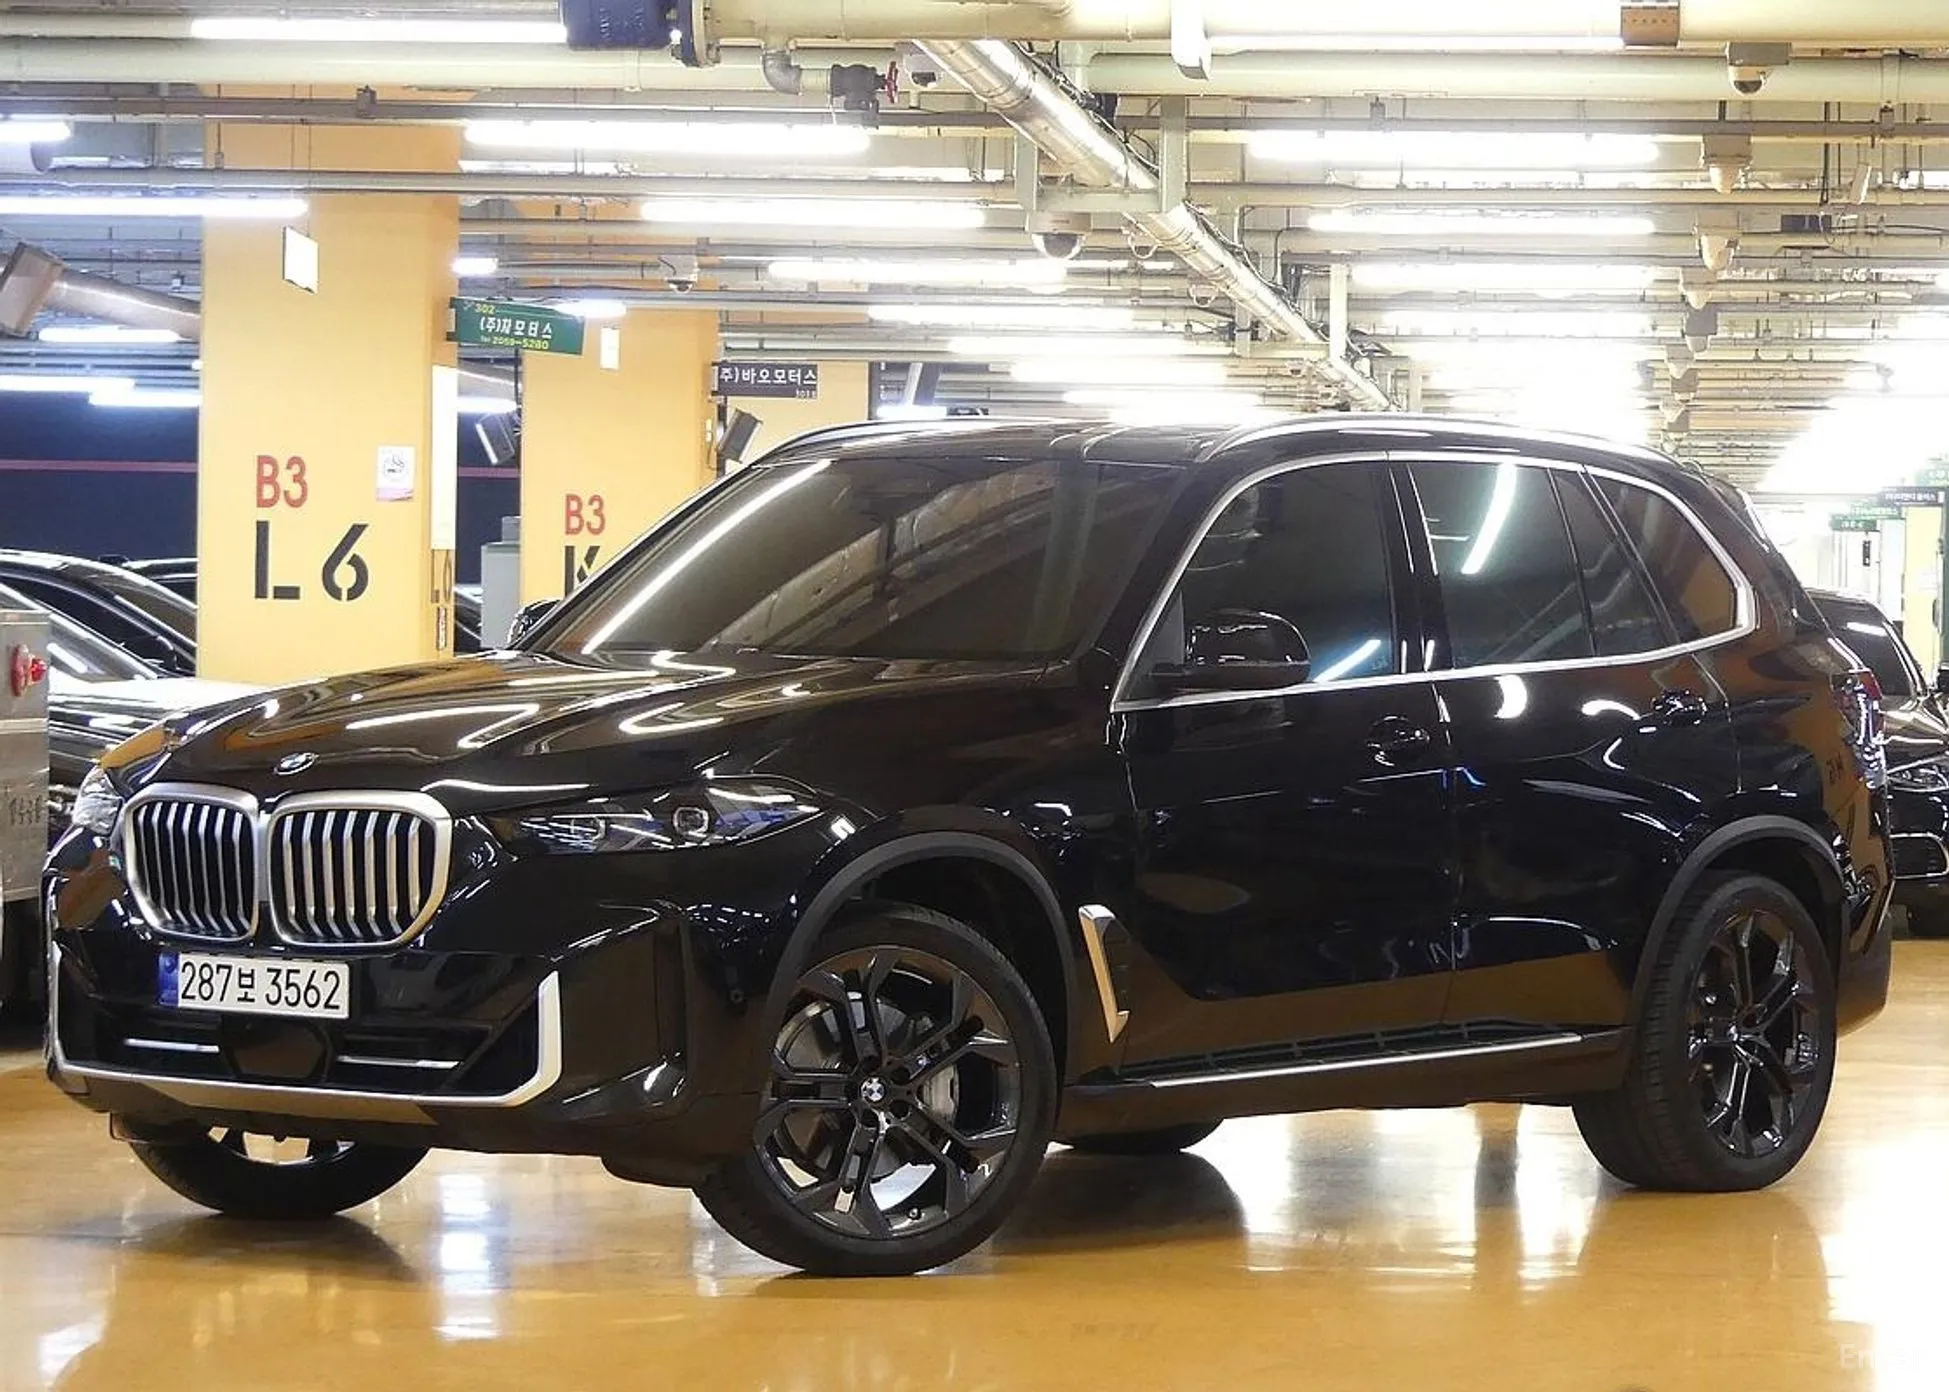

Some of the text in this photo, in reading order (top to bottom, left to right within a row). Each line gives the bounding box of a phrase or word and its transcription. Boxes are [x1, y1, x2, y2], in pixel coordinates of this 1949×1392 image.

[256, 455, 308, 508] B3
[565, 494, 606, 535] B3
[265, 967, 341, 1010] 3562
